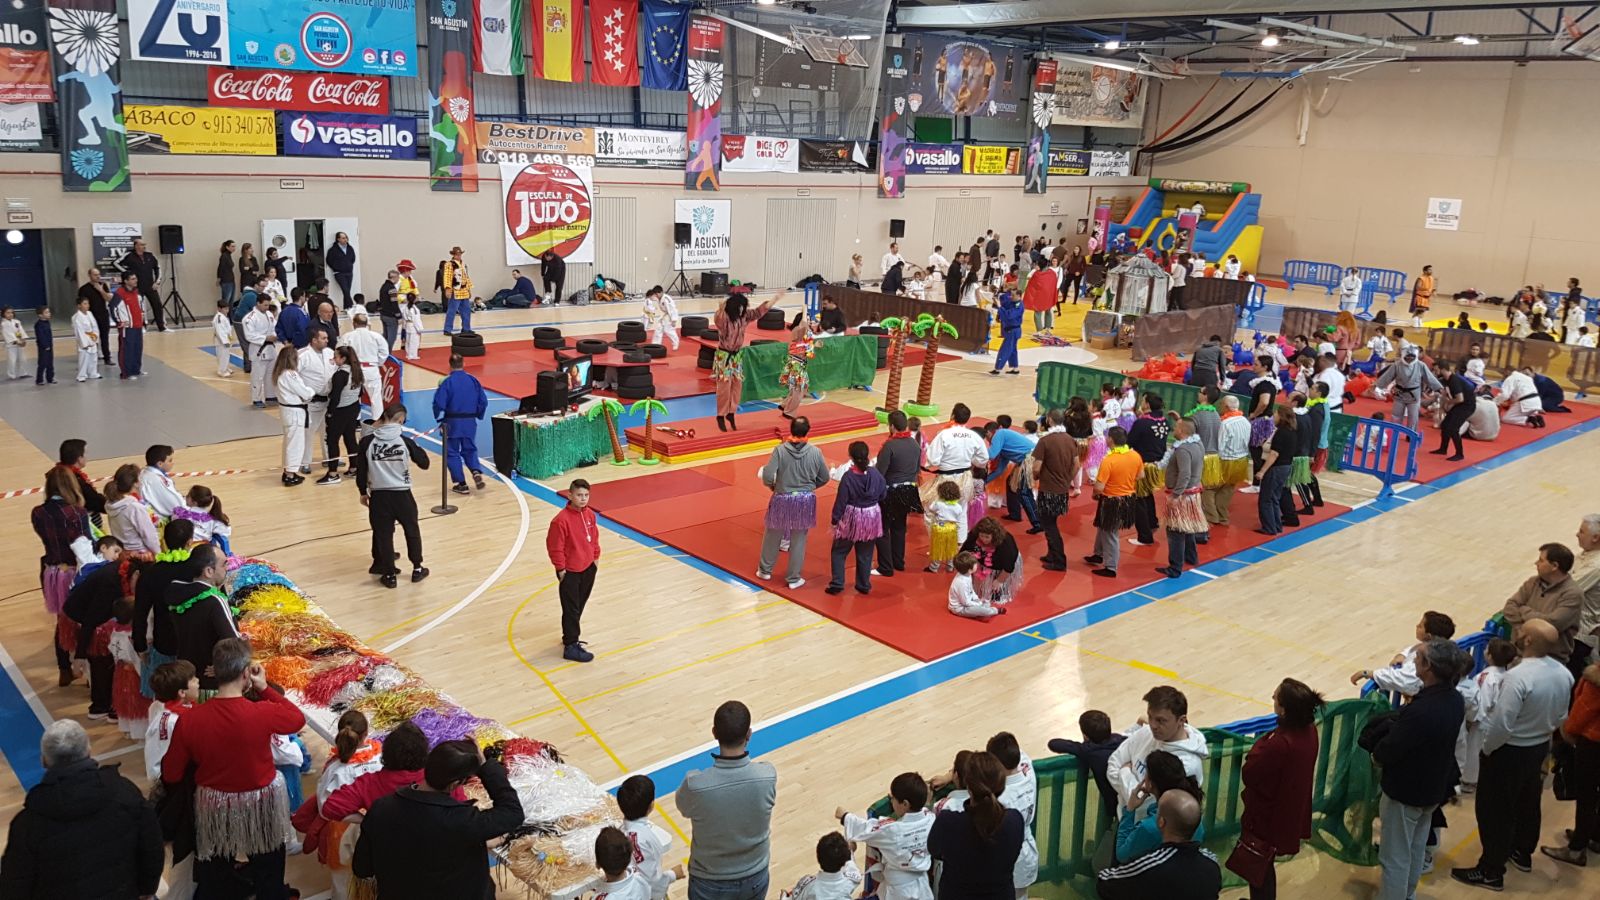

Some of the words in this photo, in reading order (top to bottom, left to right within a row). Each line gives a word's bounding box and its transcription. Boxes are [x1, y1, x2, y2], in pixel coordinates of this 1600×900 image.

[177, 1, 221, 12] ANIVERSARIO
[389, 1, 409, 10] VIDA
[430, 16, 443, 25] SAN
[444, 17, 468, 28] AGUSTÍN
[0, 23, 38, 46] llo
[185, 49, 218, 59] 1996-2016
[213, 72, 294, 102] Coca-Cola
[308, 76, 383, 107] Coca-Cola
[124, 106, 196, 126] ÁBACO
[213, 114, 232, 134] 915
[235, 115, 253, 134] 340
[256, 117, 274, 135] 578
[317, 124, 414, 147] vasallo
[489, 123, 583, 142] BestDrive
[488, 139, 535, 149] Autocentros
[498, 152, 529, 164] 918
[533, 153, 563, 165] 489
[567, 155, 595, 167] 569
[915, 149, 961, 165] vasallo
[529, 191, 562, 200] ESCUELA
[694, 233, 730, 249] AGUSTÍN
